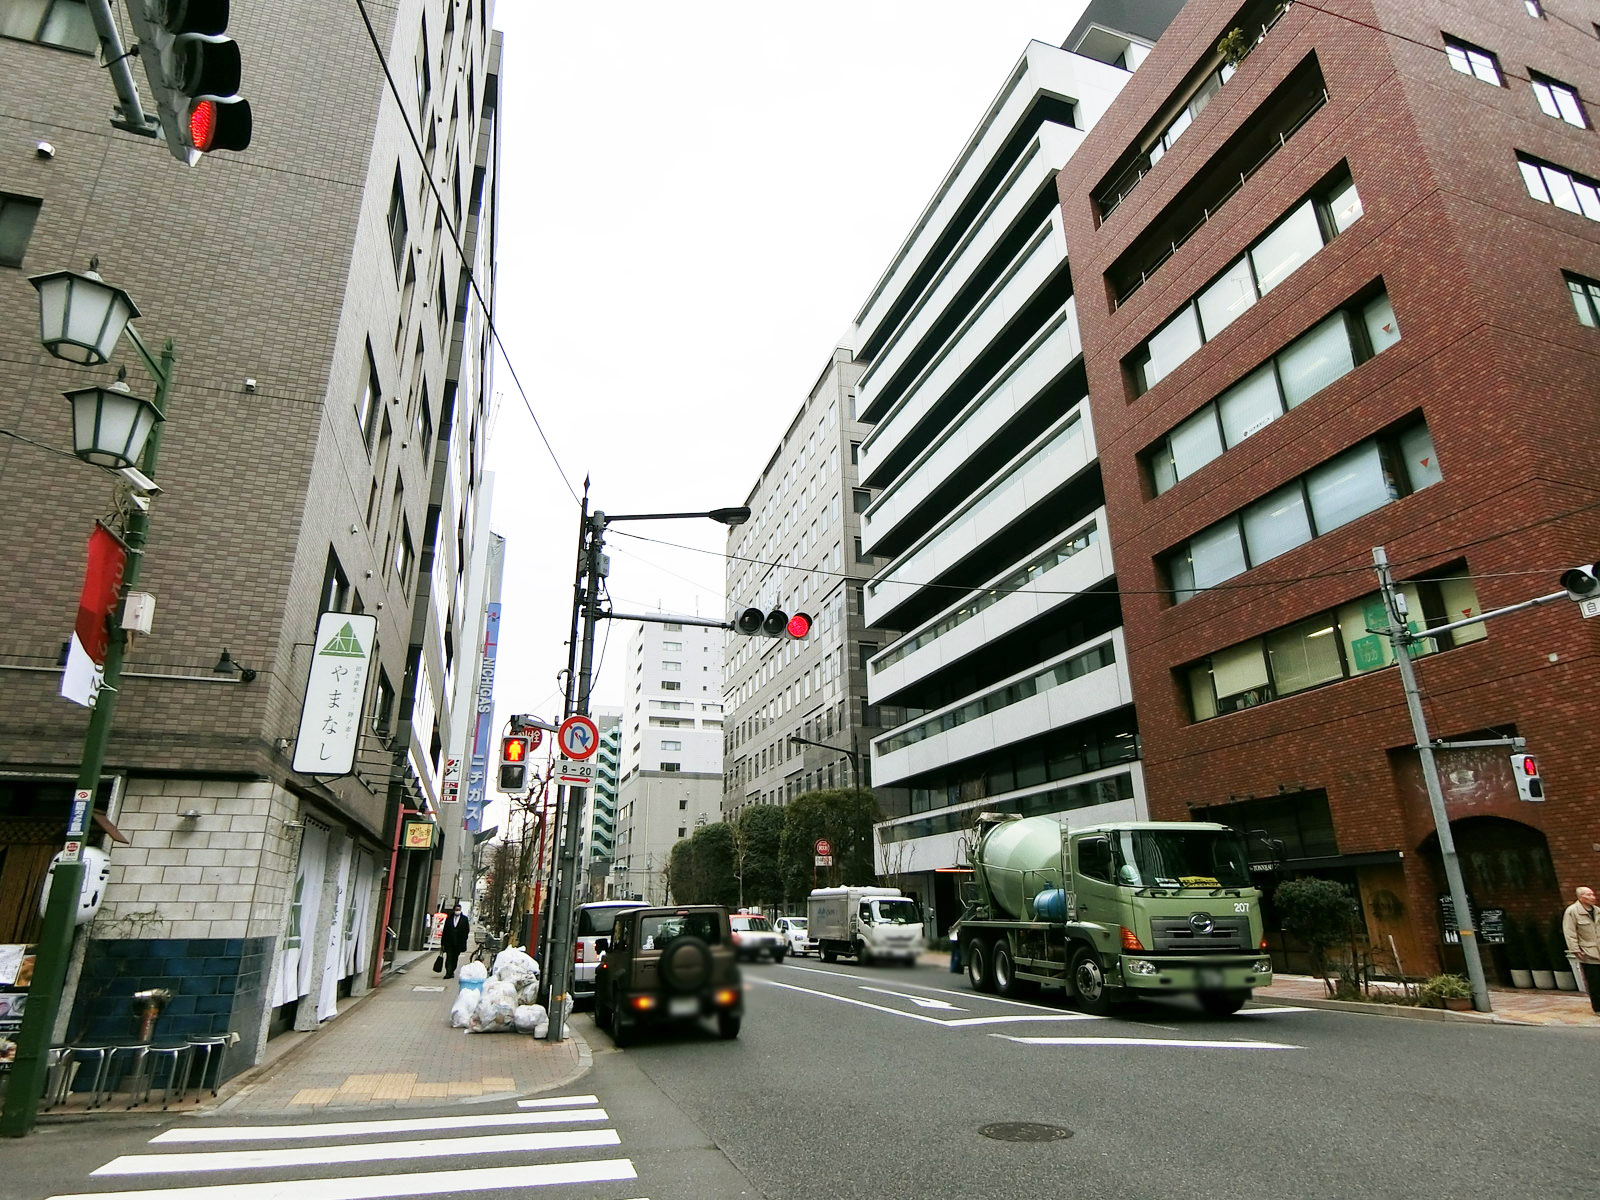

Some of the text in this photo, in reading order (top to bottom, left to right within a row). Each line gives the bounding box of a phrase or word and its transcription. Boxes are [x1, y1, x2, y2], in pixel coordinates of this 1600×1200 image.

[319, 664, 349, 761] やまなし
[477, 657, 495, 713] NICHIGAS
[466, 755, 485, 820] ニチガス
[1233, 902, 1251, 913] 207
